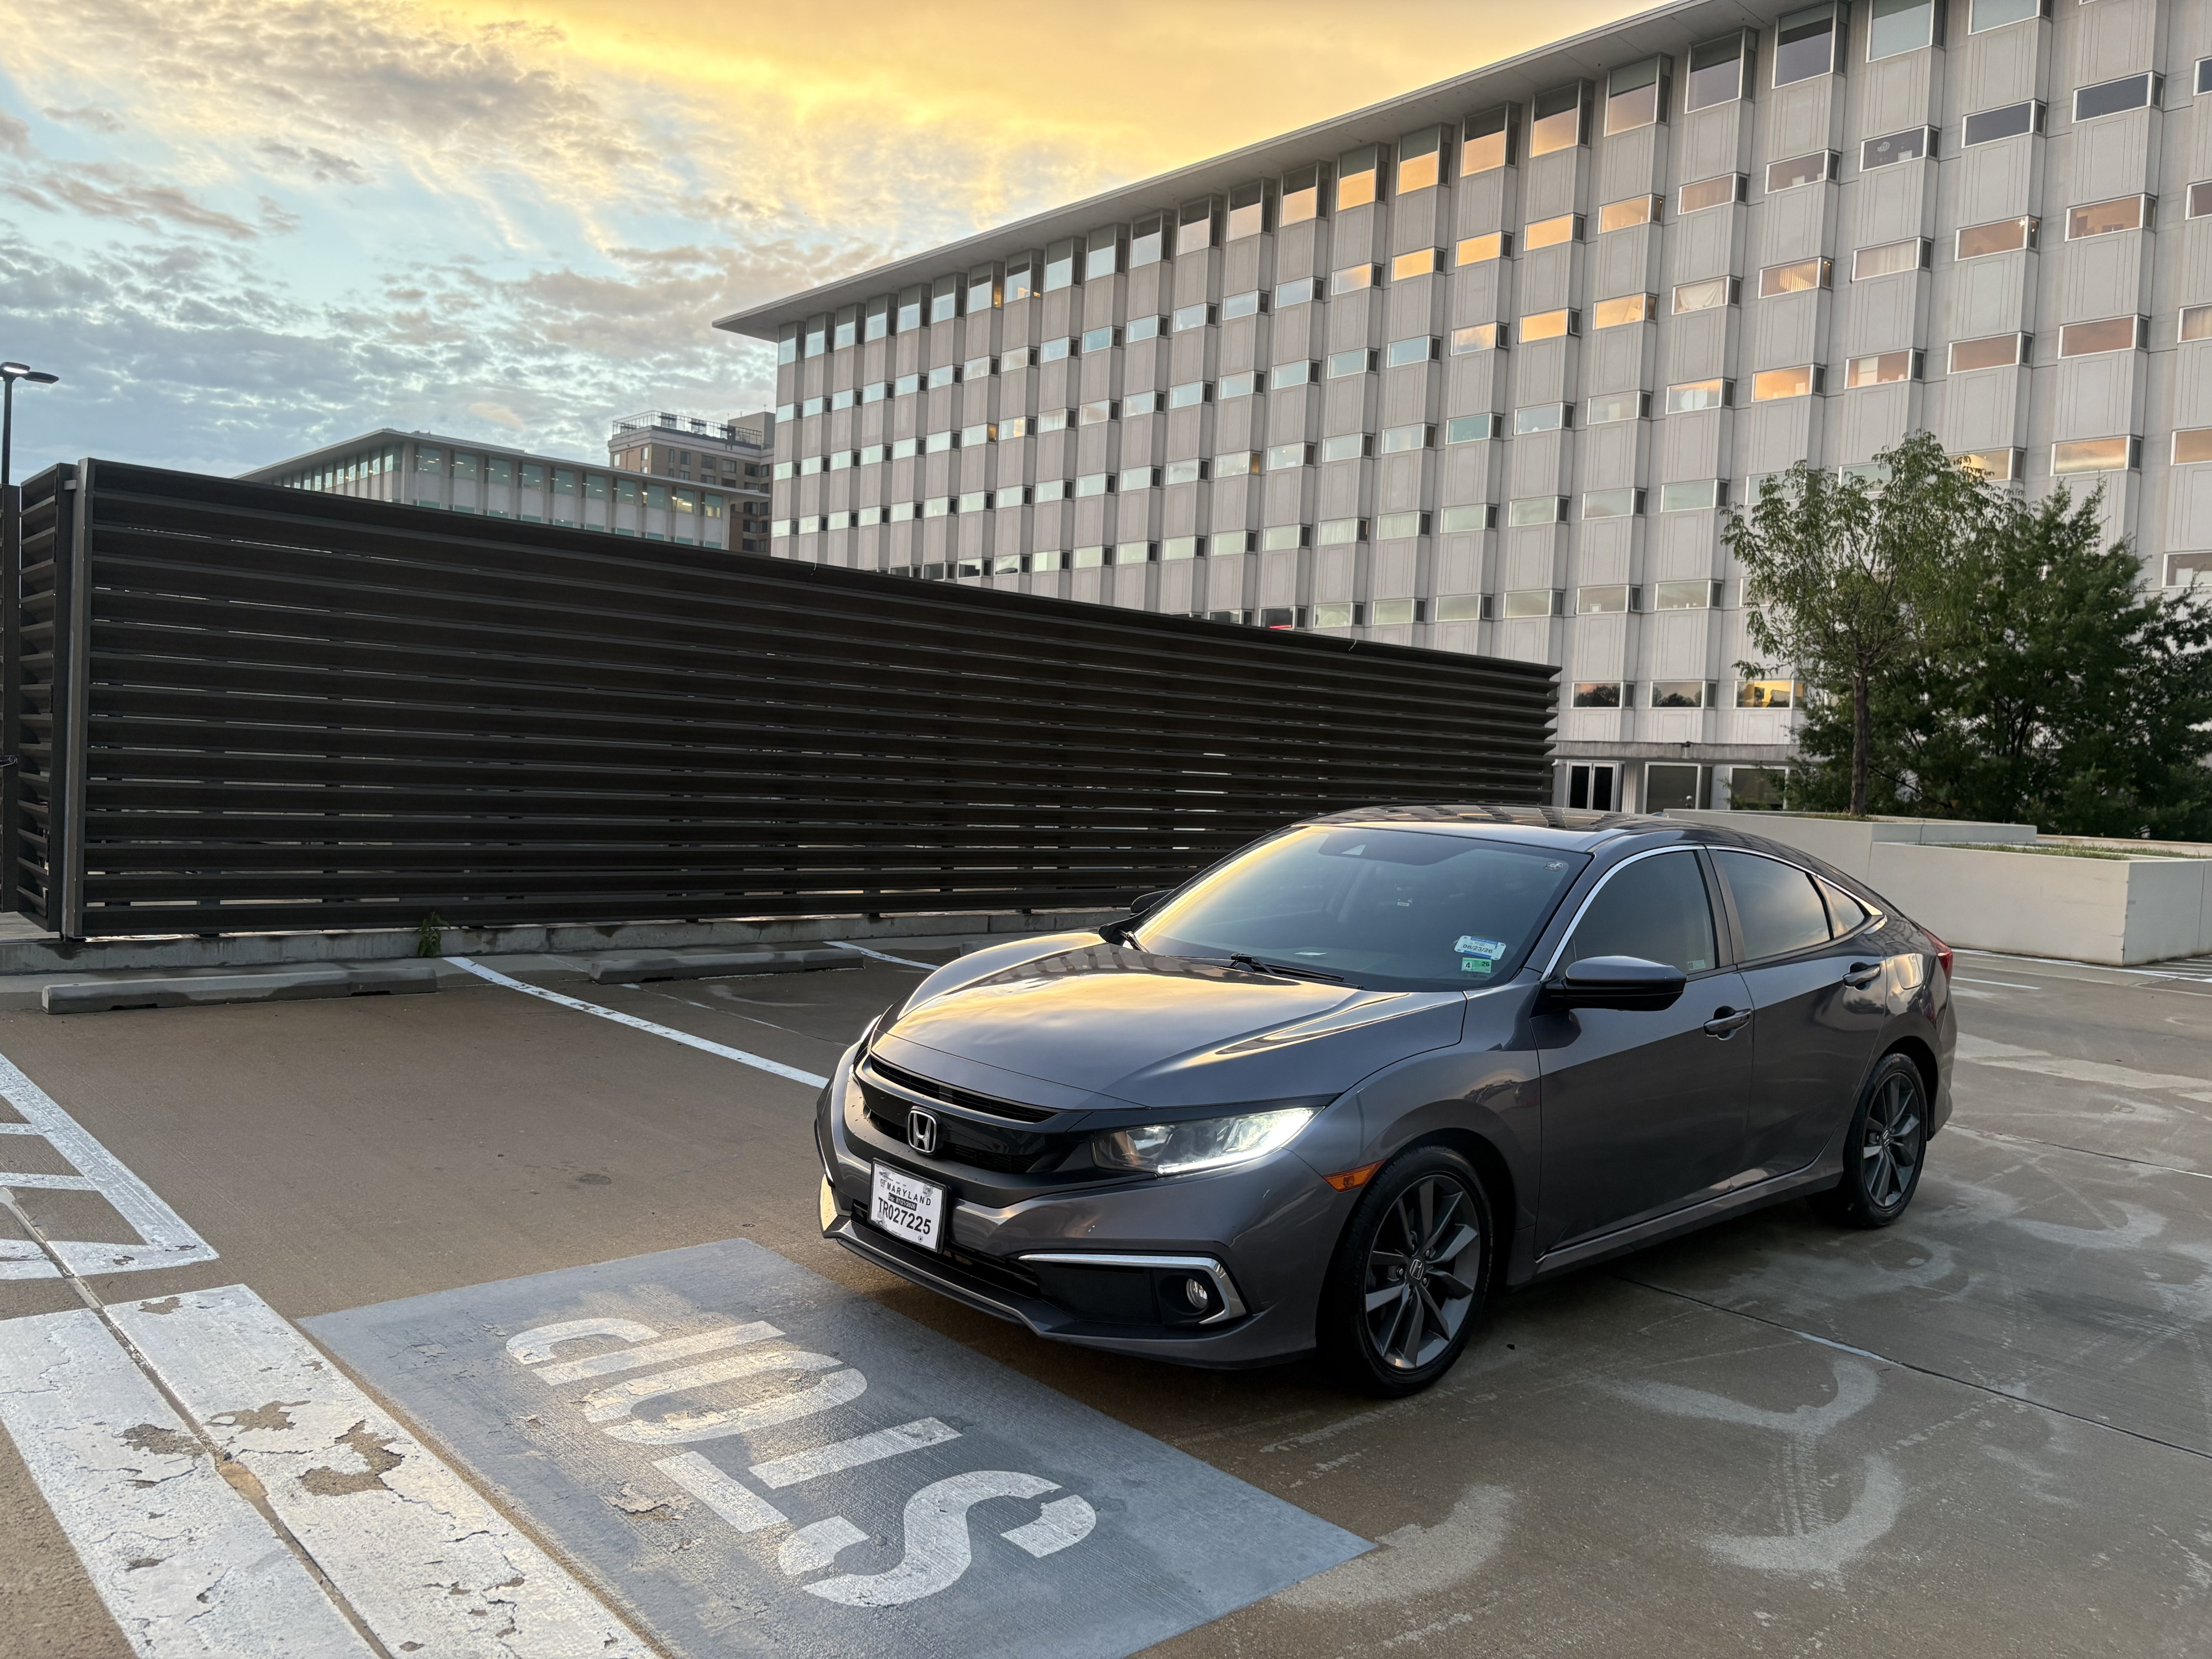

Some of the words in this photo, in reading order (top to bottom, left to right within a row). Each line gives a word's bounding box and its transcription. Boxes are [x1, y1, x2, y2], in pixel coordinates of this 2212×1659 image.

[886, 1182, 931, 1206] MARYLAND
[878, 1196, 932, 1235] TR027225
[505, 1317, 1097, 1606] STOP
